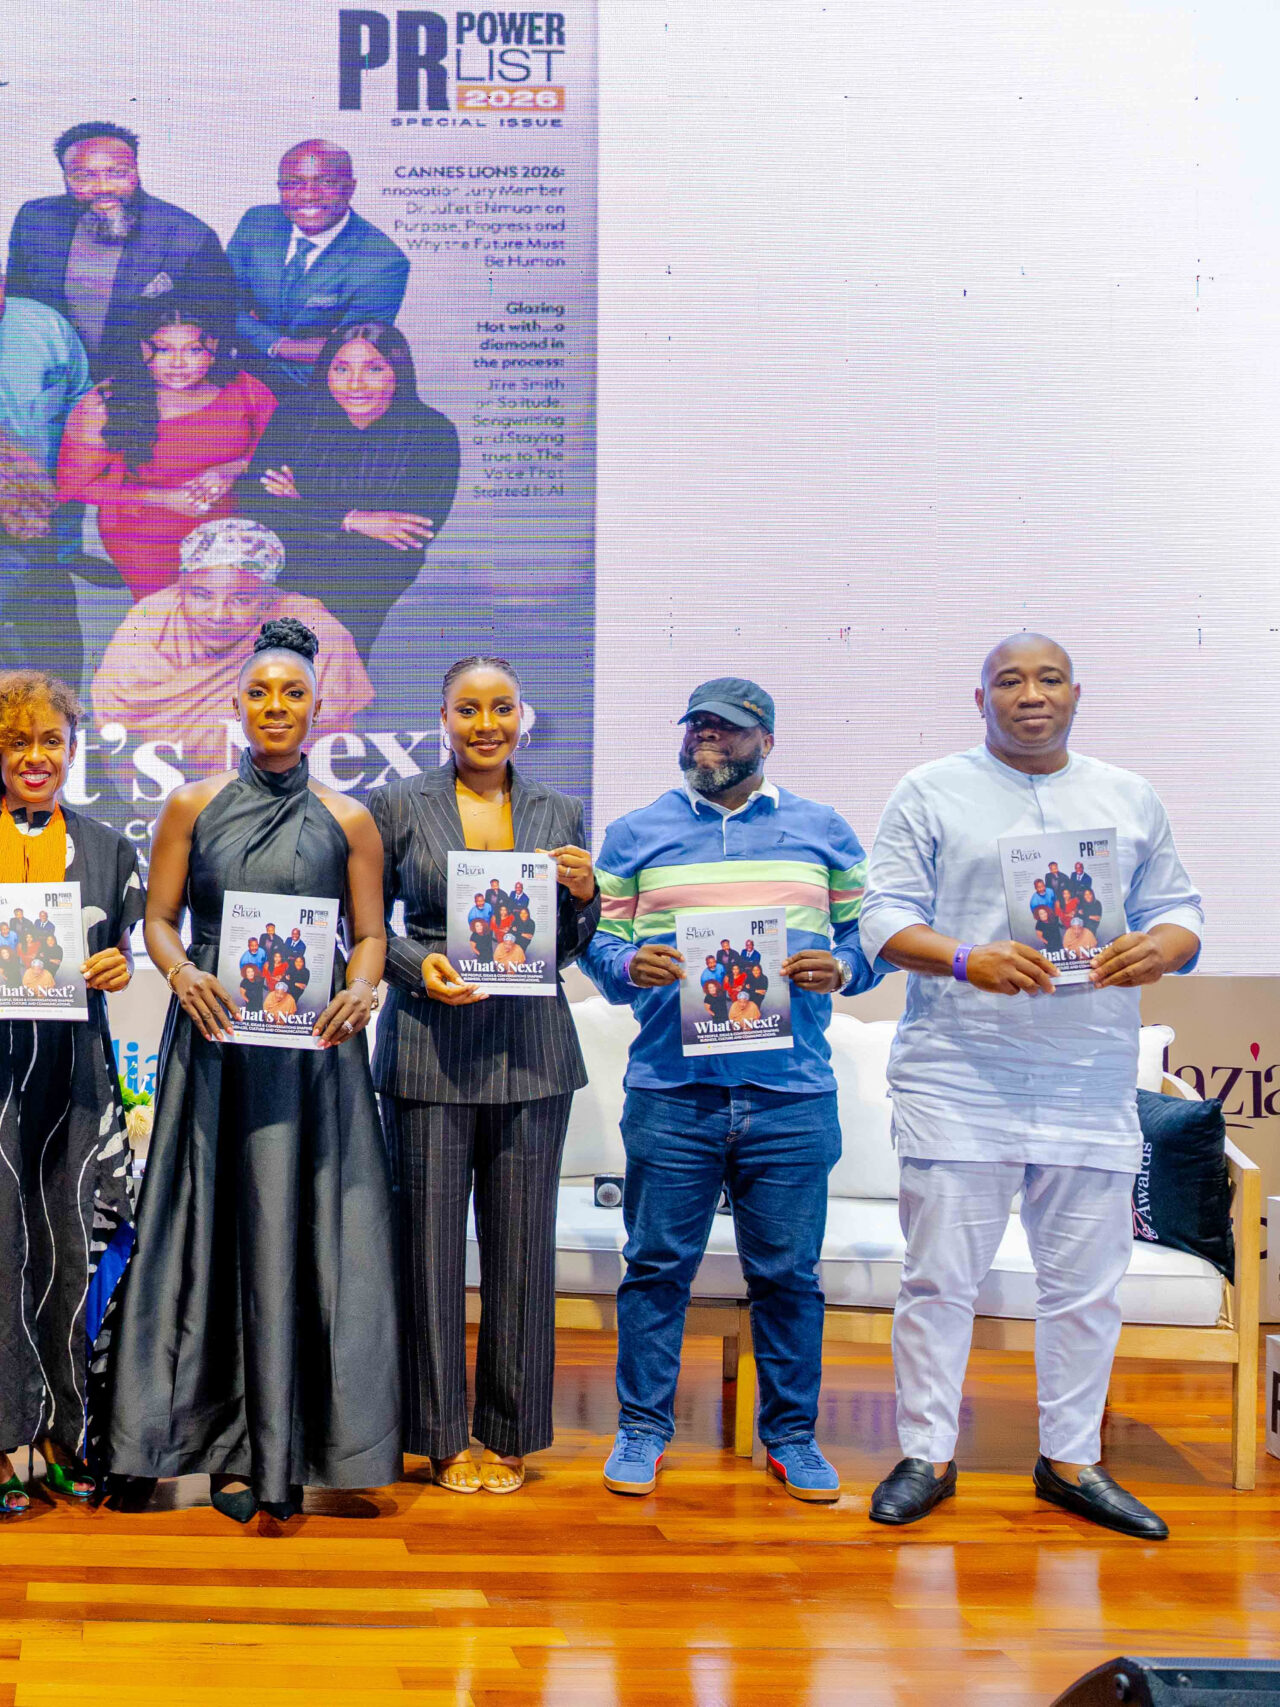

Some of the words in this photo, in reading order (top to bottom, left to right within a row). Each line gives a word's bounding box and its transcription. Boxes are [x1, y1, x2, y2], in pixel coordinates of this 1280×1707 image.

[456, 12, 565, 45] POWER
[339, 9, 450, 111] PR
[456, 48, 565, 82] LIST
[463, 90, 558, 107] 2026
[390, 118, 487, 127] SPECIAL
[499, 118, 564, 127] ISSUE
[395, 166, 465, 178] CANNES
[470, 166, 518, 178] LIONS
[522, 166, 565, 178] 2026:
[535, 219, 565, 231] and
[506, 301, 566, 317] Glazing
[477, 321, 505, 332] Hot
[480, 338, 548, 350] diamond
[551, 337, 565, 350] in
[473, 357, 498, 368] the
[502, 358, 565, 369] process:
[1079, 841, 1094, 857] PR
[522, 864, 534, 878] PR
[45, 893, 58, 907] PR
[299, 909, 314, 925] PR
[751, 920, 764, 935] PR
[1039, 947, 1077, 961] hat's
[459, 959, 505, 973] What's
[507, 960, 545, 973] Next?
[37, 984, 75, 998] Next?
[228, 1006, 274, 1023] hat's
[277, 1010, 316, 1025] Next?
[694, 1020, 740, 1034] What's
[743, 1014, 780, 1030] Next?
